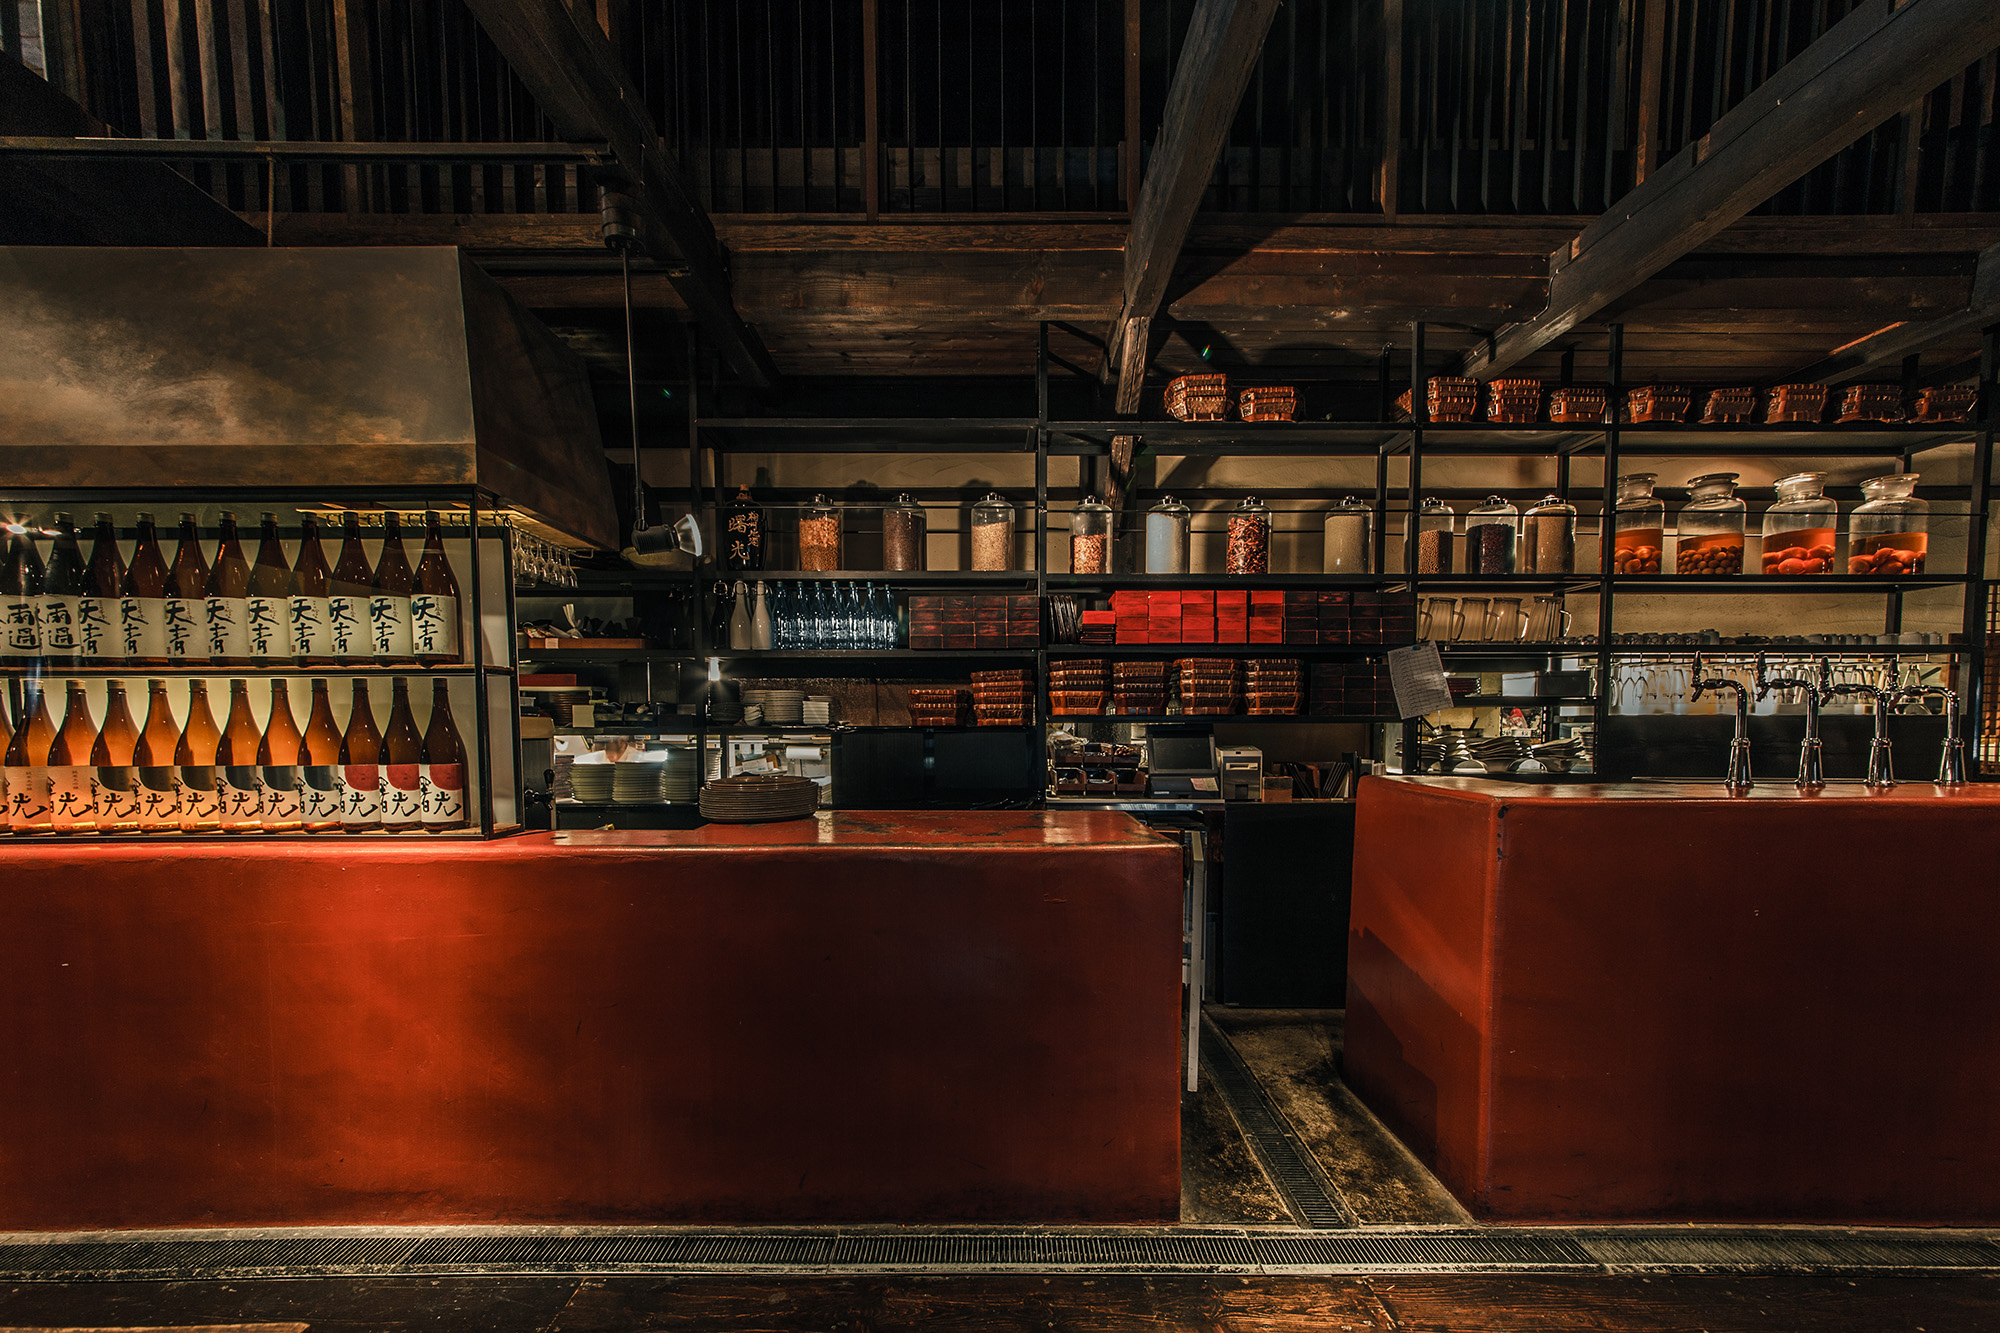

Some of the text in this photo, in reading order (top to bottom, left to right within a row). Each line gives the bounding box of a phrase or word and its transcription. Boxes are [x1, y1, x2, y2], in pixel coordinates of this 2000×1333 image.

[7, 602, 41, 650] 雨過
[46, 602, 80, 650] 雨過
[79, 599, 111, 655] 天青
[121, 599, 149, 655] 天青
[166, 600, 197, 656] 天青
[207, 599, 236, 655] 天青
[249, 599, 280, 655] 天青
[291, 599, 322, 655] 天青
[331, 598, 359, 654] 天青
[372, 598, 402, 654] 天青
[415, 597, 445, 652] 天青
